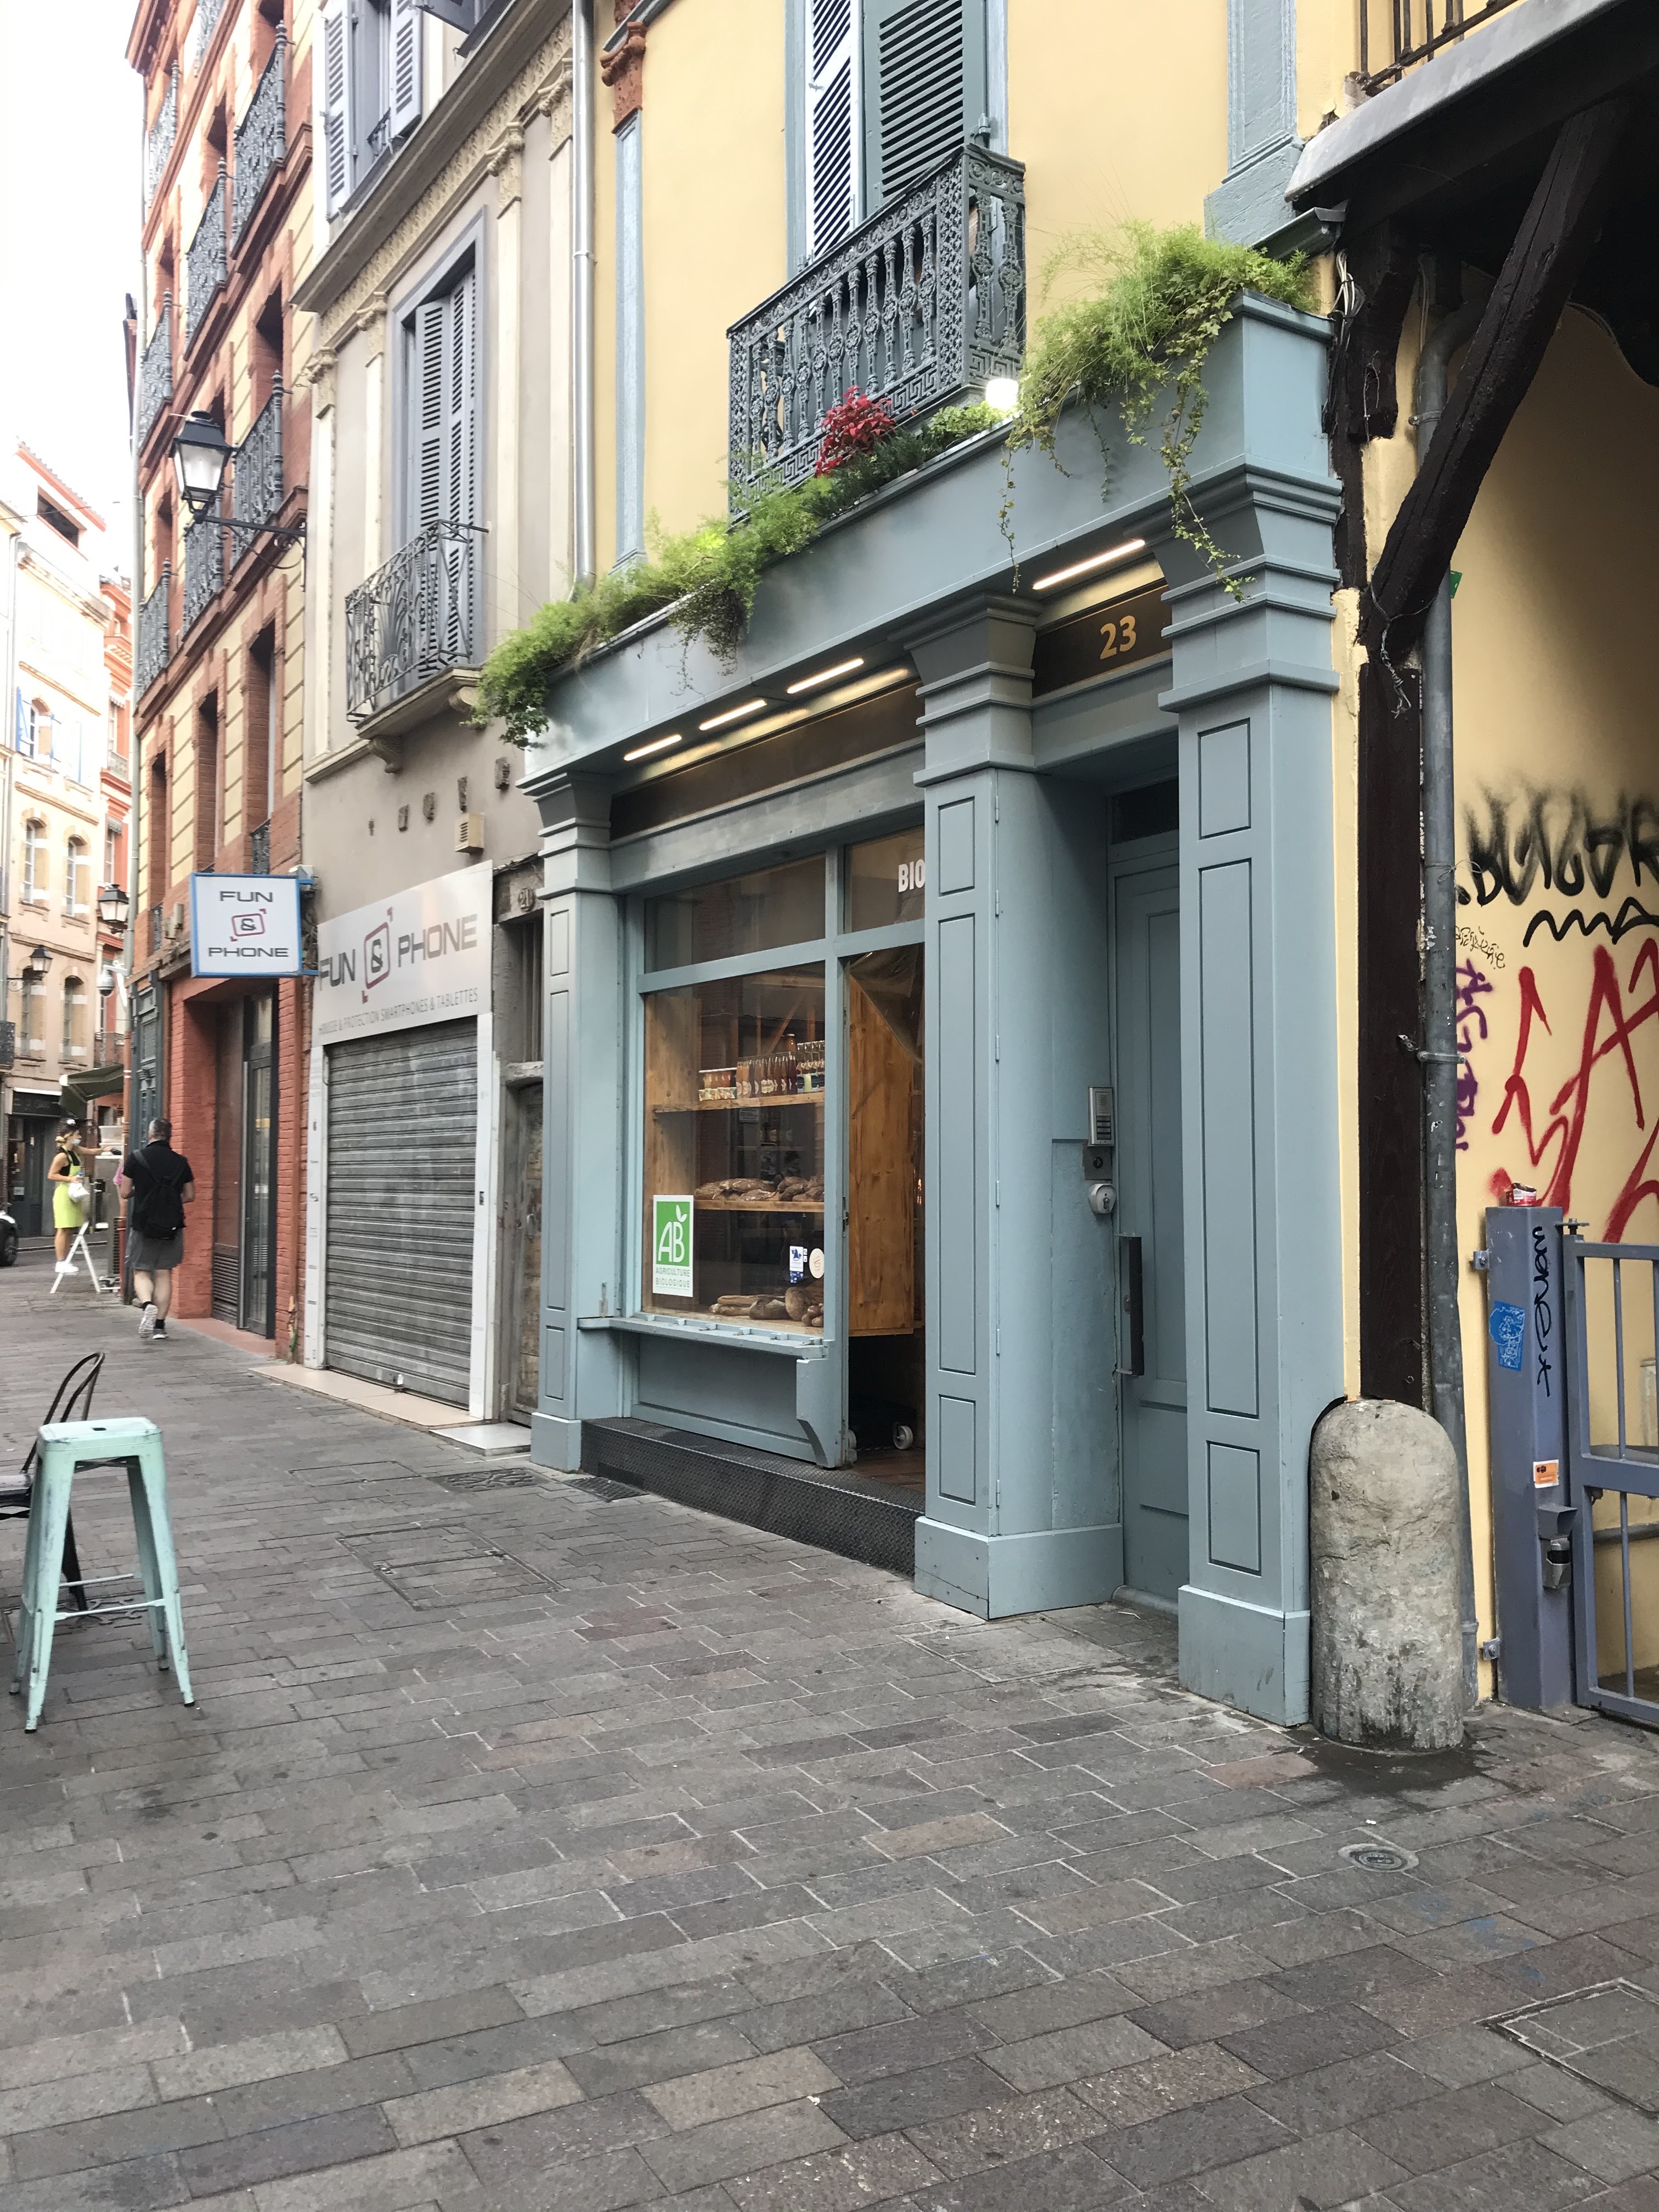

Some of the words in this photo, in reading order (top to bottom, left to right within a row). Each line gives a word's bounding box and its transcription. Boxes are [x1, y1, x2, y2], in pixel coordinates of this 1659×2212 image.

[1100, 615, 1136, 659] 23
[898, 859, 926, 893] BIO
[219, 891, 273, 902] FUN
[240, 918, 256, 931] &
[208, 947, 289, 957] PHONE
[320, 949, 356, 991] FUN
[370, 938, 383, 974] &
[398, 913, 477, 968] PHONE
[344, 1011, 379, 1029] PROTECTION
[381, 998, 428, 1022] SMARTPHONES
[437, 988, 478, 1009] TABLETTES
[658, 1221, 685, 1263] AB
[656, 1267, 690, 1277] AGRICULTURE
[656, 1277, 690, 1288] BIOLOGIQUE
